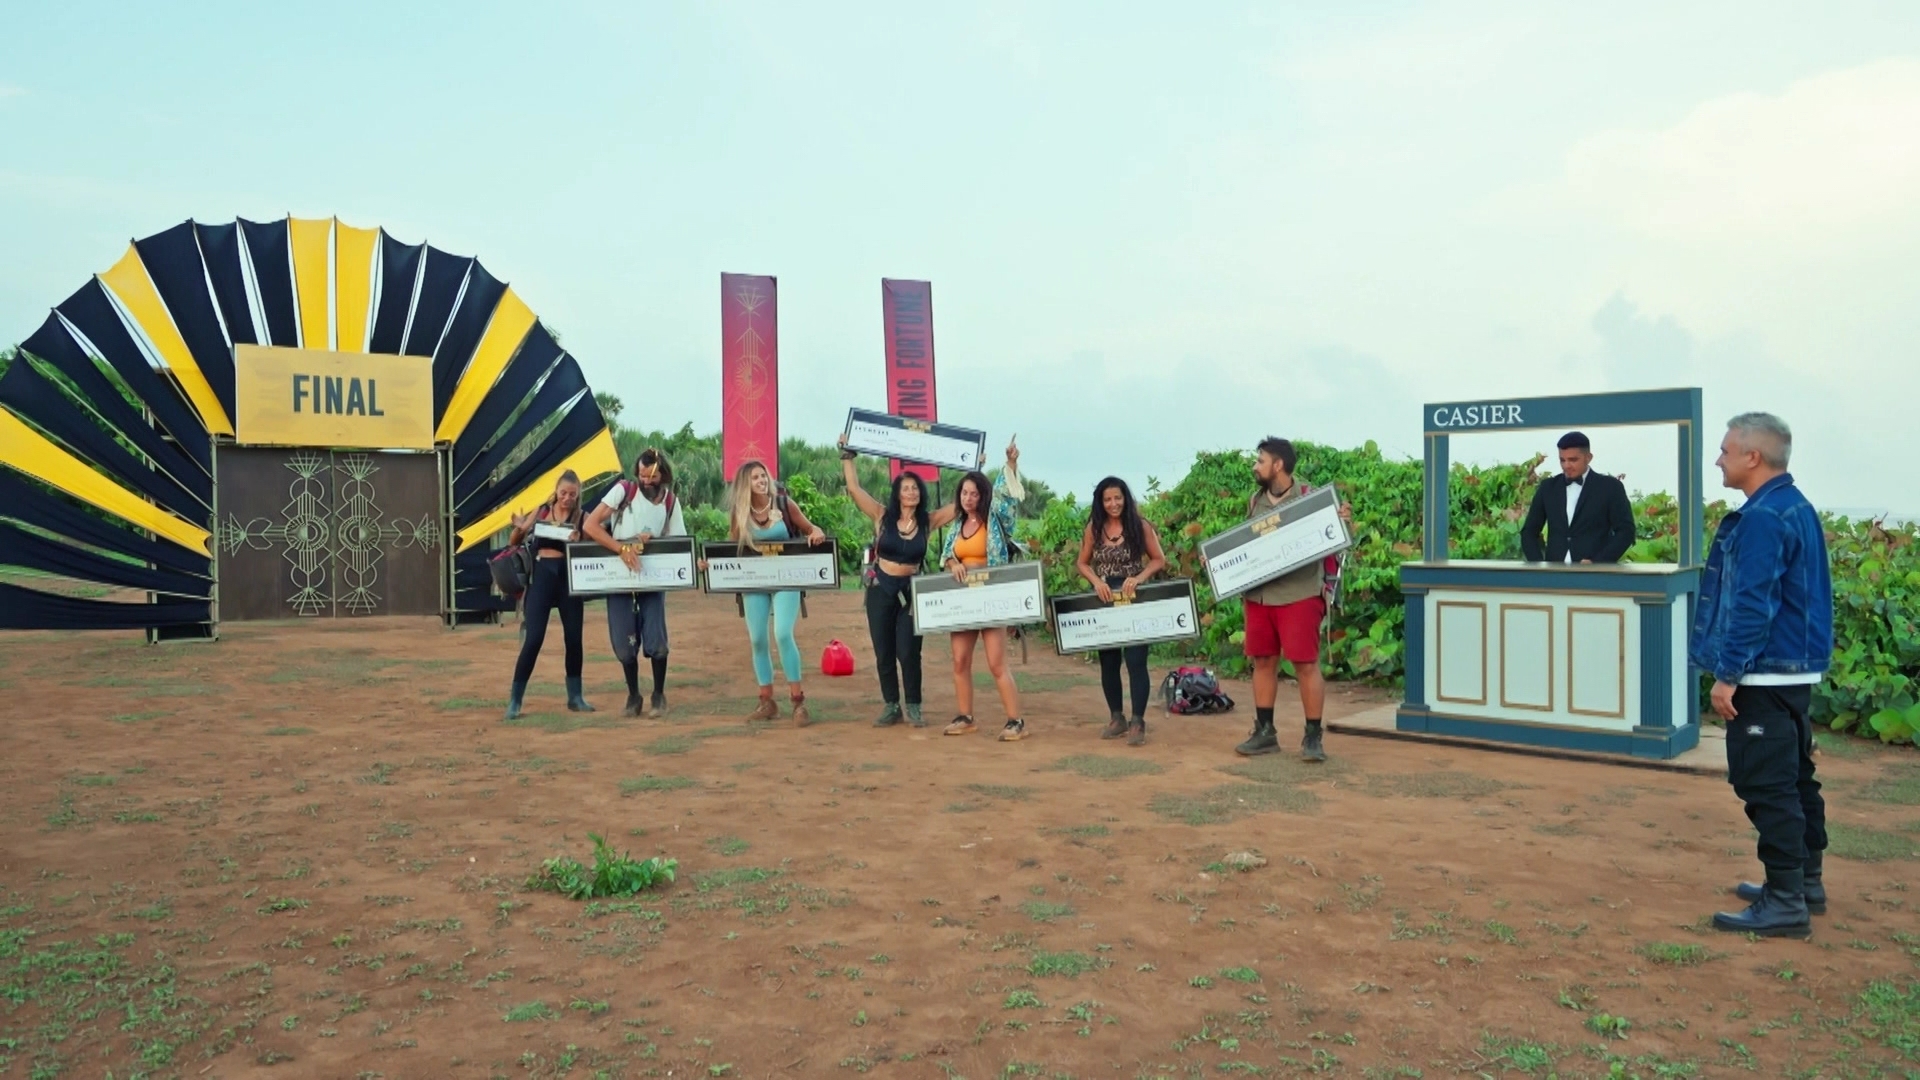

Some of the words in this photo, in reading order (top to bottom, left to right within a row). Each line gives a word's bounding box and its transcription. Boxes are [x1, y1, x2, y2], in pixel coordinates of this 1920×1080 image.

[894, 291, 926, 369] FORTUNE
[293, 374, 385, 416] FINAL
[1433, 404, 1524, 427] CASIER
[677, 567, 687, 580] €
[713, 562, 742, 571] DIANA
[819, 567, 828, 580] €
[1024, 595, 1034, 610] €
[1176, 613, 1187, 628] €
